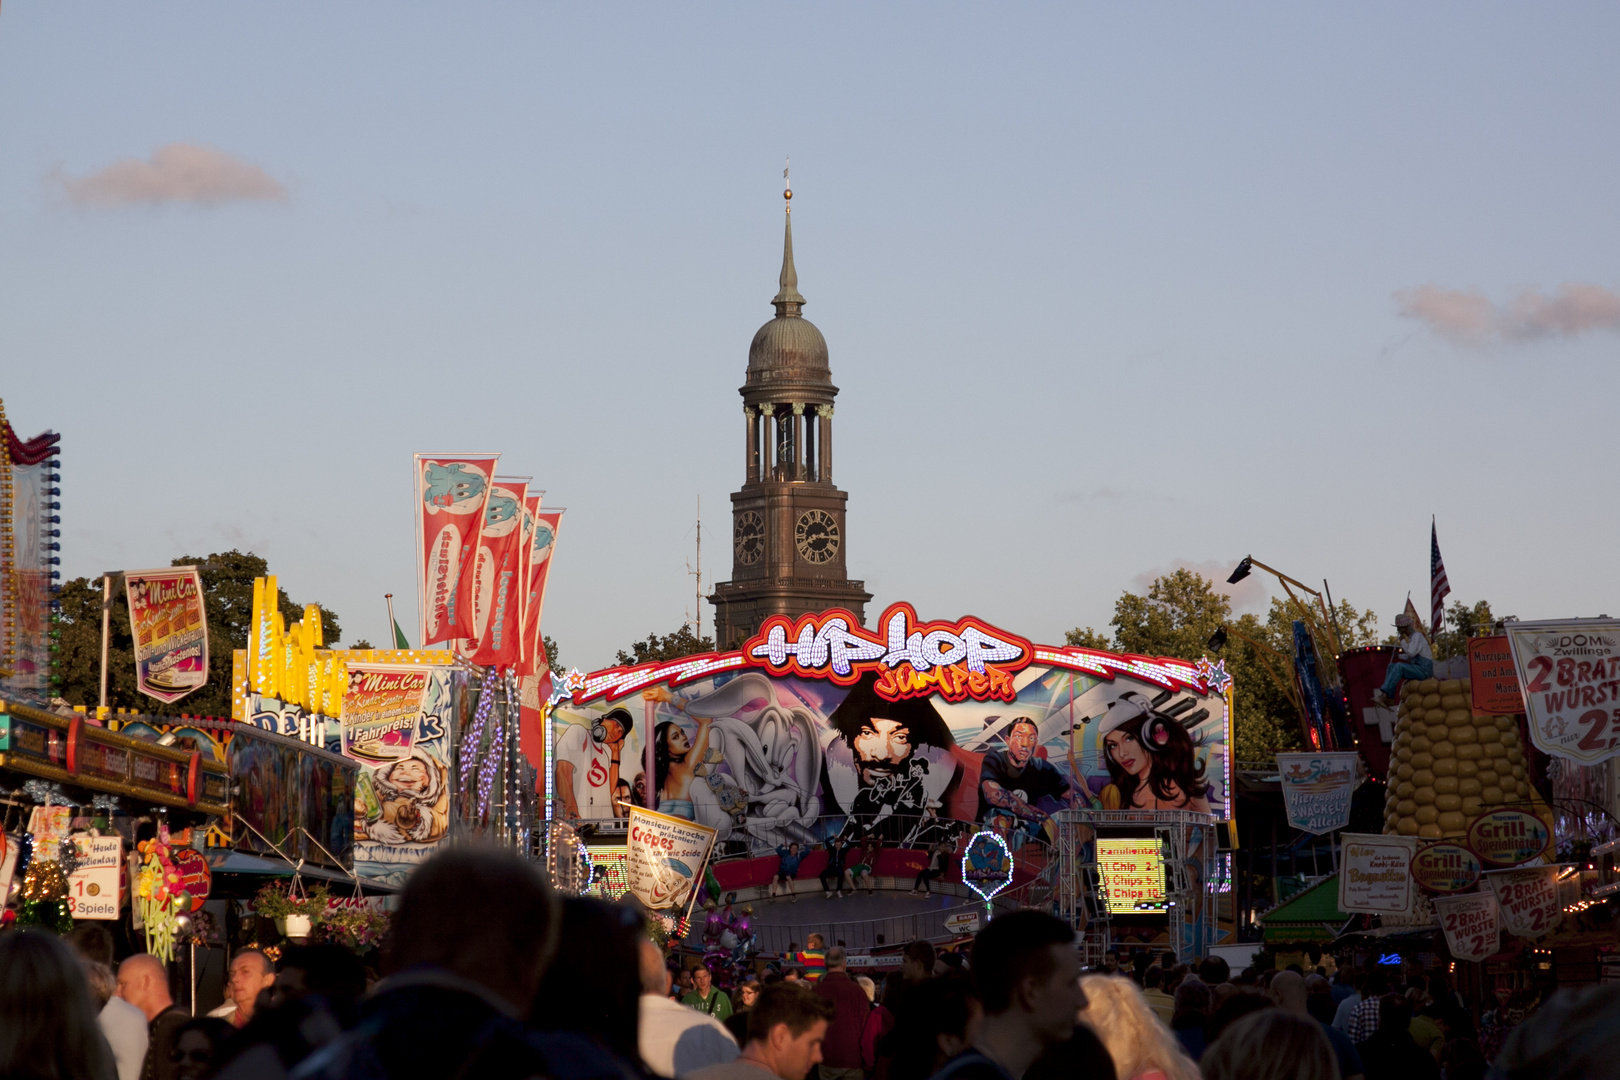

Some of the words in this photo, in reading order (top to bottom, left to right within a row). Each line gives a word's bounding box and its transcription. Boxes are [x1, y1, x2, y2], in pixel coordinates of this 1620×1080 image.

[176, 575, 197, 599] Car
[168, 626, 205, 651] Wickelraum
[1560, 634, 1603, 648] DOM
[1553, 647, 1612, 657] Zwillinge
[1482, 667, 1497, 678] und
[1527, 655, 1554, 693] 2
[363, 672, 400, 693] Mini
[400, 671, 425, 691] Car
[381, 707, 402, 719] einem
[348, 727, 353, 740] 1
[355, 716, 414, 742] Fahrpreis!
[1291, 792, 1314, 806] Hier
[1297, 801, 1347, 819] WACKELT
[634, 815, 670, 831] Monsieur
[673, 826, 706, 841] Laroche
[1306, 815, 1341, 831] Alles!
[1477, 821, 1532, 839] Grill-
[632, 826, 675, 851] Crêpes
[1477, 838, 1542, 854] Spezialitäten
[93, 843, 118, 853] Heute
[681, 850, 702, 858] Seide
[1113, 862, 1137, 873] Chip
[1418, 854, 1467, 868] Grill-
[1113, 874, 1143, 887] Chips
[1418, 868, 1475, 881] Spezialitäten
[75, 880, 83, 896] 1
[1500, 885, 1513, 906] 2
[78, 902, 115, 916] Spiele
[1446, 913, 1458, 932] 2
